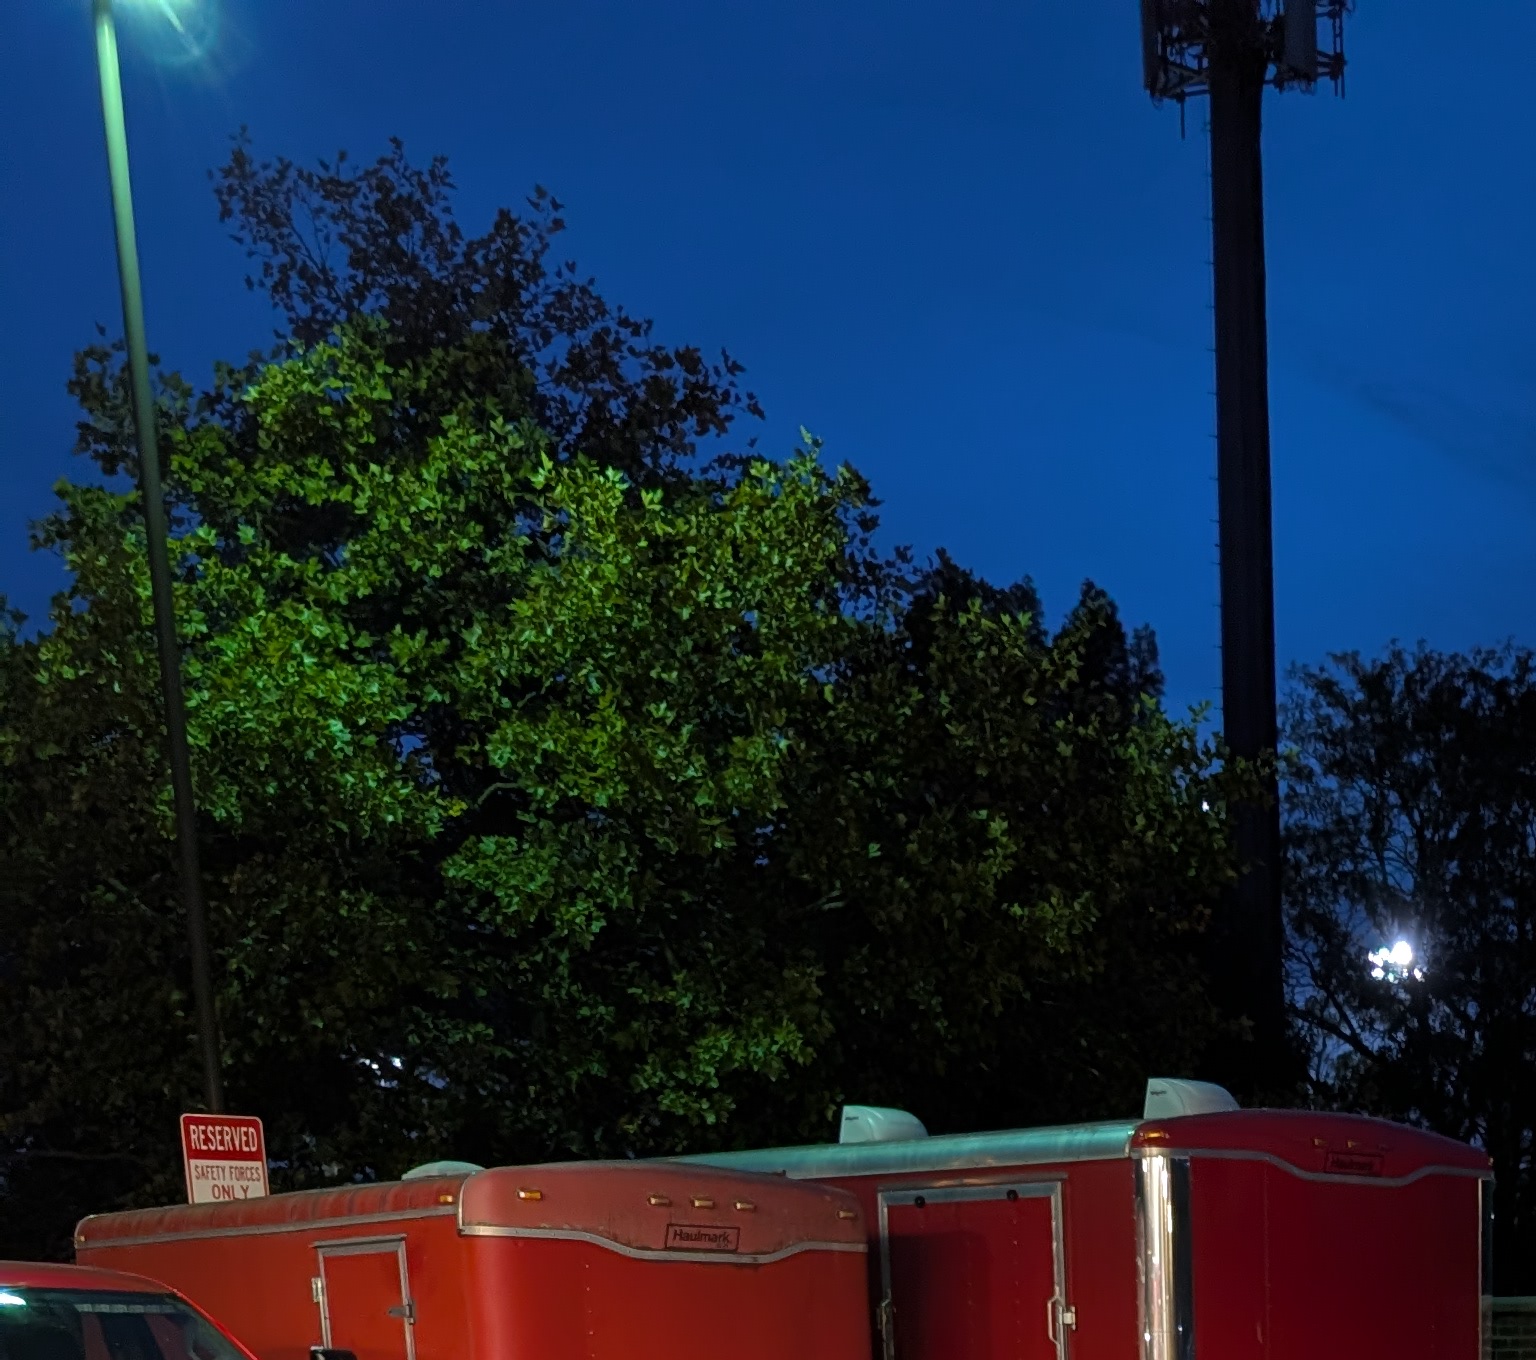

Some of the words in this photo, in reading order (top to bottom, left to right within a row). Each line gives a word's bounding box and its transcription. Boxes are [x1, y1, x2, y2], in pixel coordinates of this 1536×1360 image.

[189, 1124, 258, 1151] RESERVED
[194, 1164, 226, 1181] SAFETY
[229, 1165, 260, 1182] FORCES
[211, 1183, 250, 1200] ONLY
[672, 1229, 729, 1243] Haulmark
